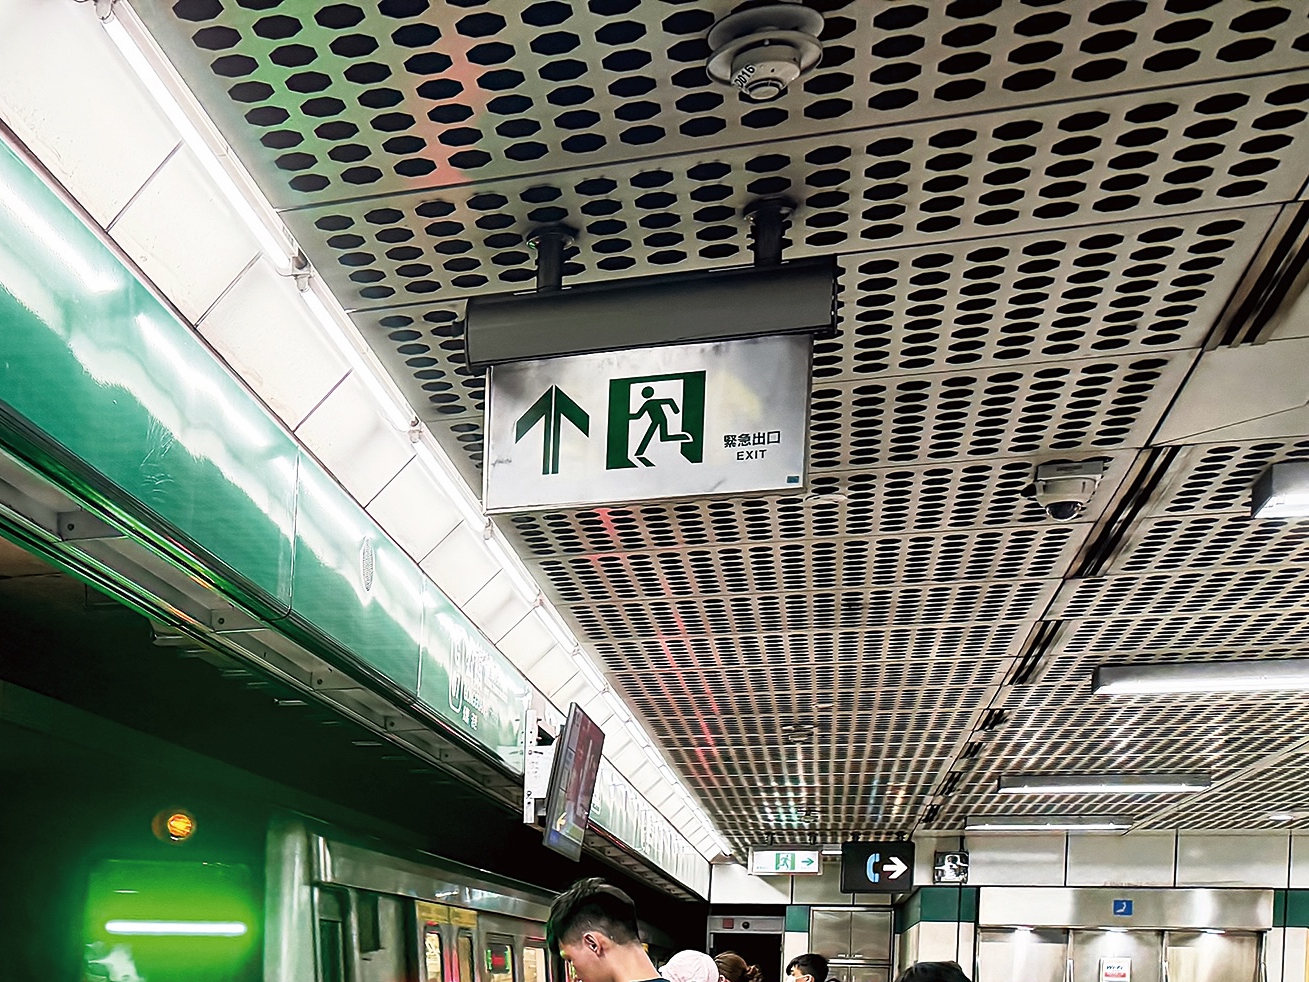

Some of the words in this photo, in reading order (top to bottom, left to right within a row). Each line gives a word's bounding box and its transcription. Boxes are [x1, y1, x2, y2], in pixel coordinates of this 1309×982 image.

[723, 431, 781, 448] 緊急出口
[736, 449, 767, 461] EXIT
